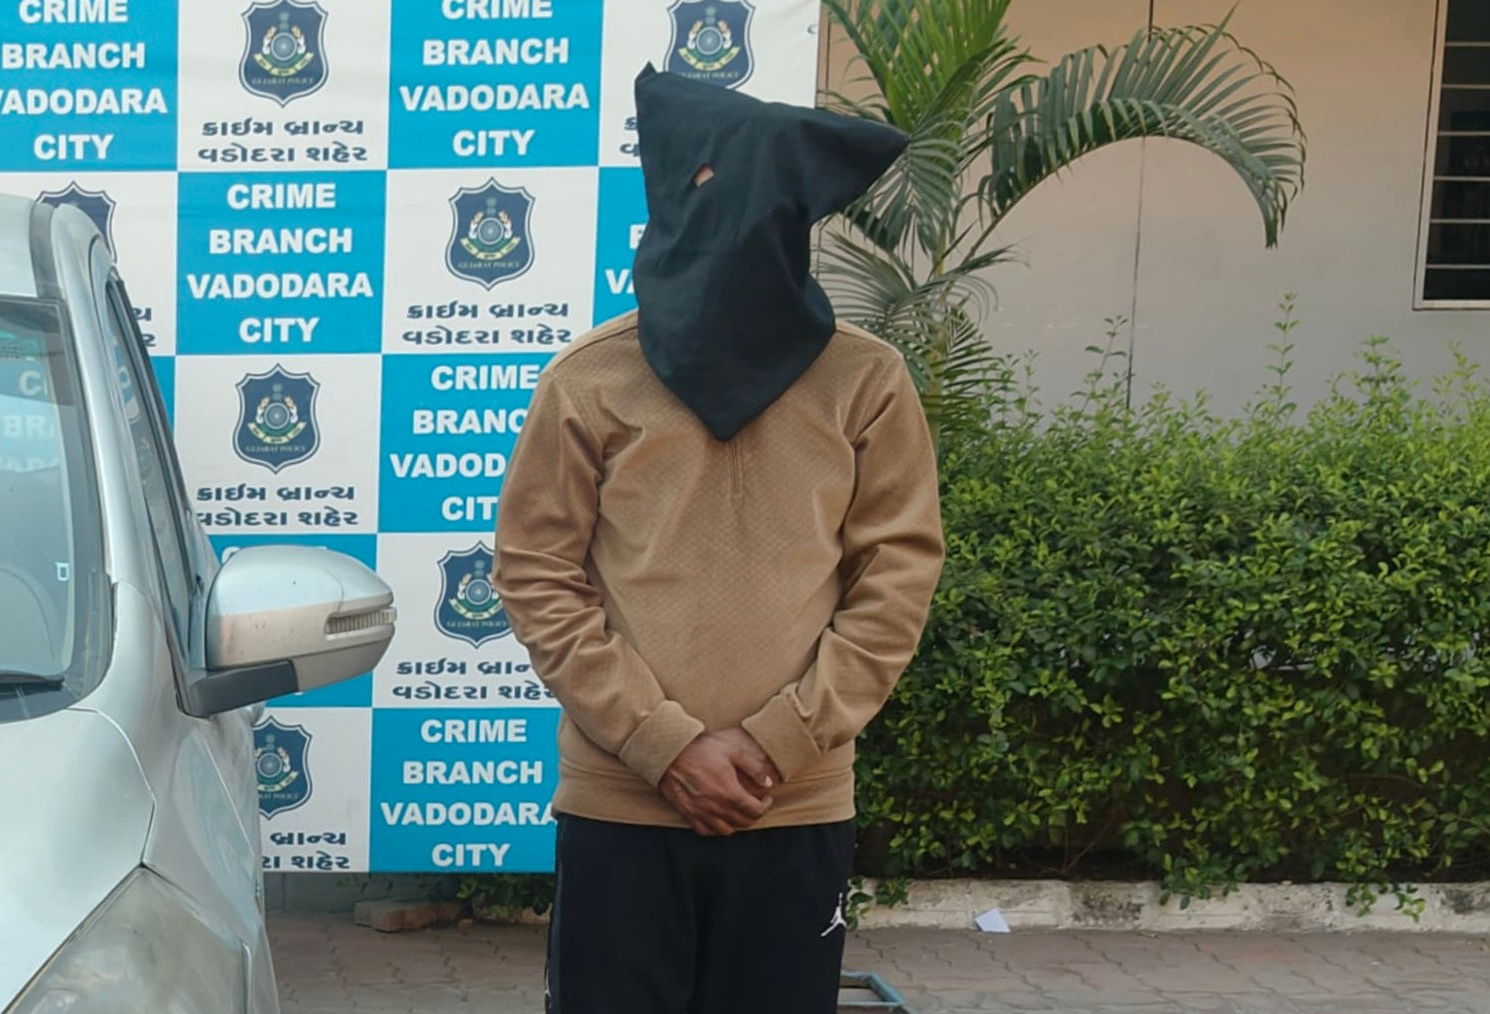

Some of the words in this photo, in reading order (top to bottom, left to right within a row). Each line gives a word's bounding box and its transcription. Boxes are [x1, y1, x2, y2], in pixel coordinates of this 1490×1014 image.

[19, 0, 127, 23] CRIME
[442, 0, 552, 19] CRIME
[2, 43, 145, 69] BRANCH
[424, 38, 568, 65] BRANCH
[400, 84, 589, 110] VADODARA
[284, 121, 363, 136] બ્રાન્ચ
[34, 134, 113, 160] CITY
[198, 142, 294, 162] વડોદરા
[306, 141, 367, 163] શહેર
[454, 130, 534, 156] CITY
[227, 183, 335, 209] CRIME
[210, 228, 352, 254] BRANCH
[187, 273, 372, 299] VADODARA
[489, 303, 568, 318] બ્રાન્ચ
[240, 318, 318, 342] CITY
[402, 325, 499, 345] વડોદરા
[511, 324, 571, 344] શહેર
[432, 364, 540, 391] CRIME
[414, 410, 528, 434] BRANC
[391, 453, 506, 477] VADOD
[277, 487, 354, 501] બ્રાન્ચ
[298, 506, 358, 527] શહેર
[443, 497, 499, 520] CIT
[392, 681, 487, 699] વડોદરા
[422, 720, 526, 742] CRIME
[404, 761, 542, 784] BRANCH
[382, 803, 558, 825] VADODARA
[270, 832, 346, 845] બ્રાન્ચ
[291, 850, 350, 870] શહેર
[433, 844, 509, 866] CITY
